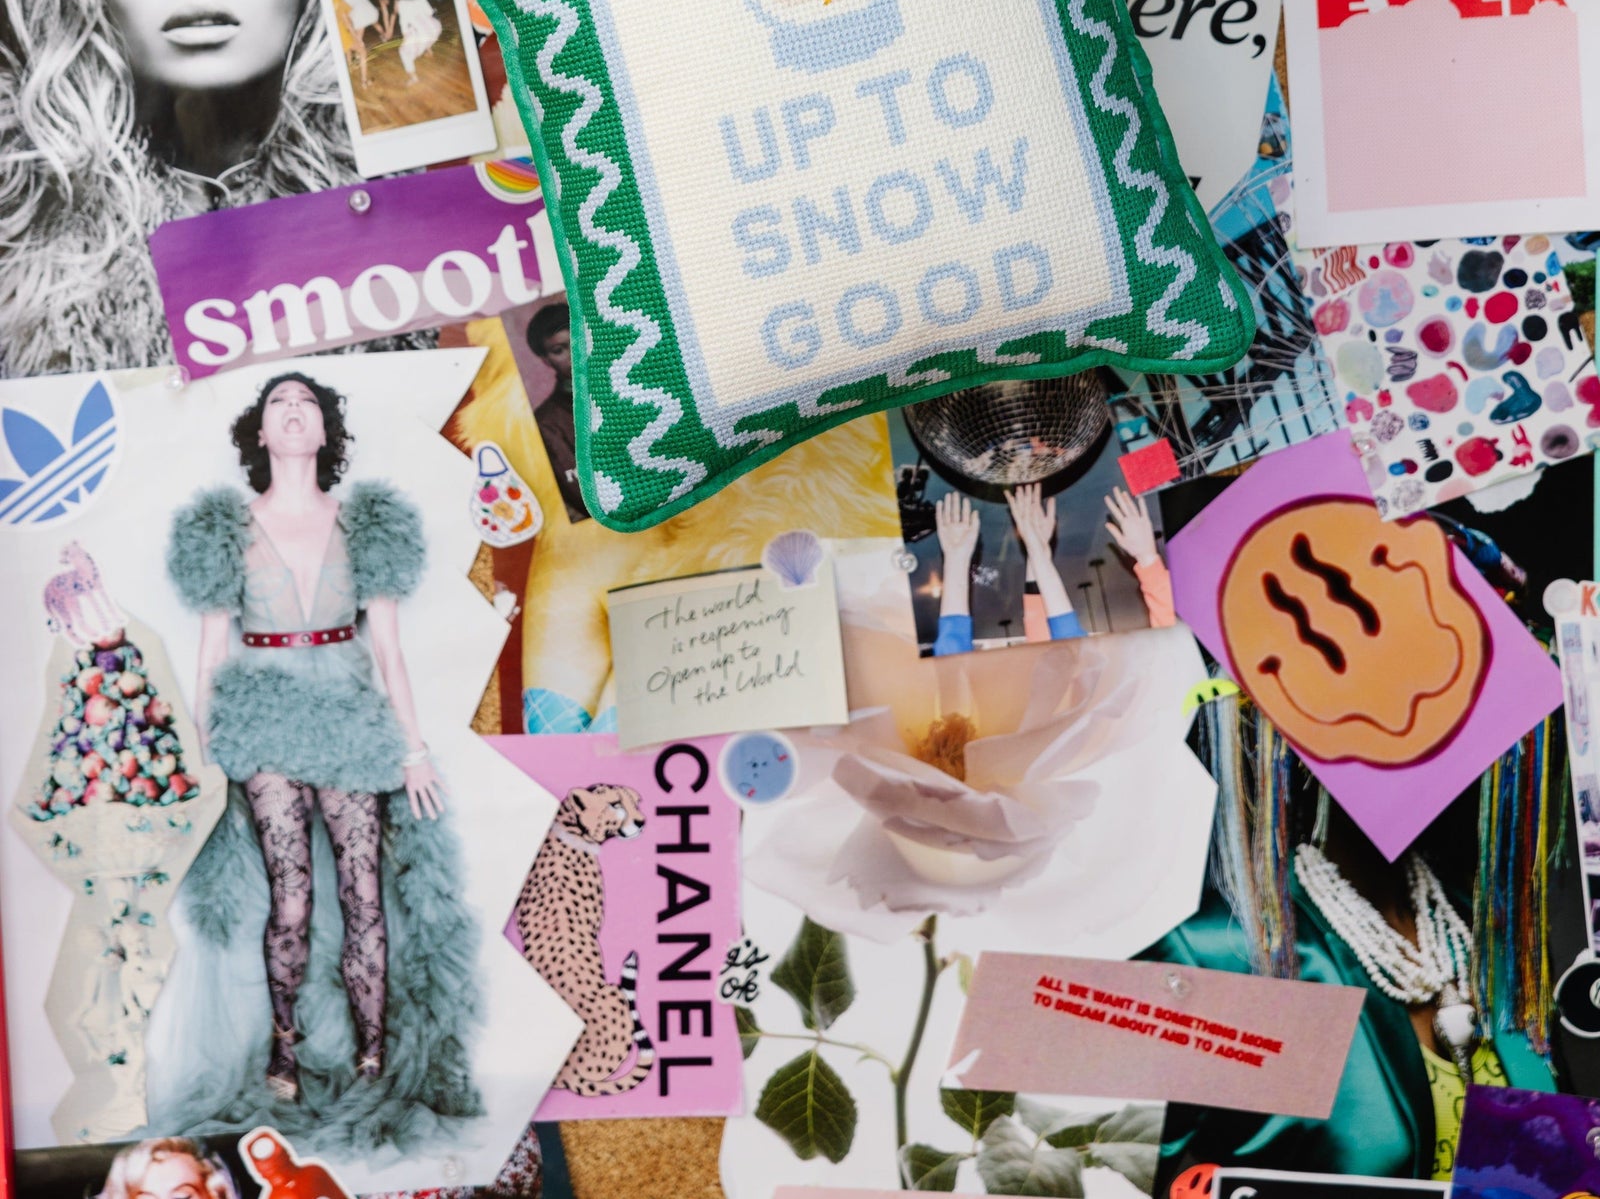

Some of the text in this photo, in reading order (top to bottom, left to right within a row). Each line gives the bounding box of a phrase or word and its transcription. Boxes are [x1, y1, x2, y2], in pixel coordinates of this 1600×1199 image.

[717, 50, 994, 184] UP TO
[731, 136, 1029, 279] SNOW
[759, 241, 1053, 370] GOOD
[702, 578, 762, 617] world
[654, 743, 713, 1097] CHANEL
[1034, 992, 1266, 1068] TO DREAM ABOUT AND TO ADORE
[1037, 975, 1284, 1054] ALL WE WANT IS SOMETHING MORE
